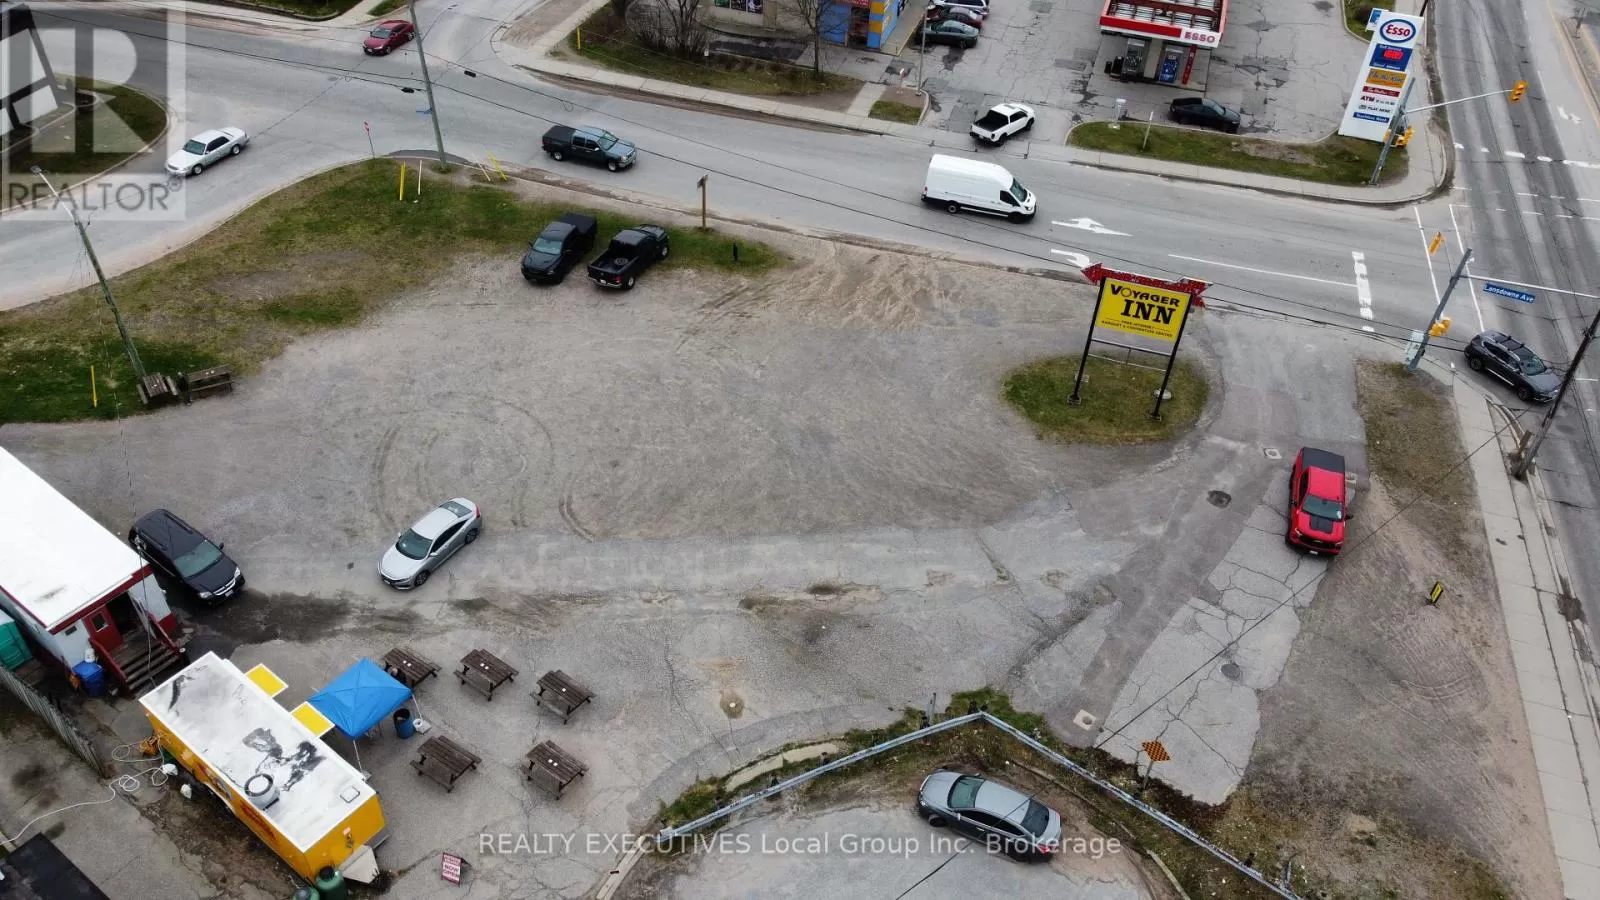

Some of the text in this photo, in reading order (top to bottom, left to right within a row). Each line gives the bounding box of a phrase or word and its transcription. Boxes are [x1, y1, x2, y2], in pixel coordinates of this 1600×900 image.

[1184, 31, 1216, 43] ESSO
[1110, 283, 1181, 308] VOYAGER
[1484, 284, 1534, 303] Lansdowne Ave
[1120, 299, 1176, 325] INN
